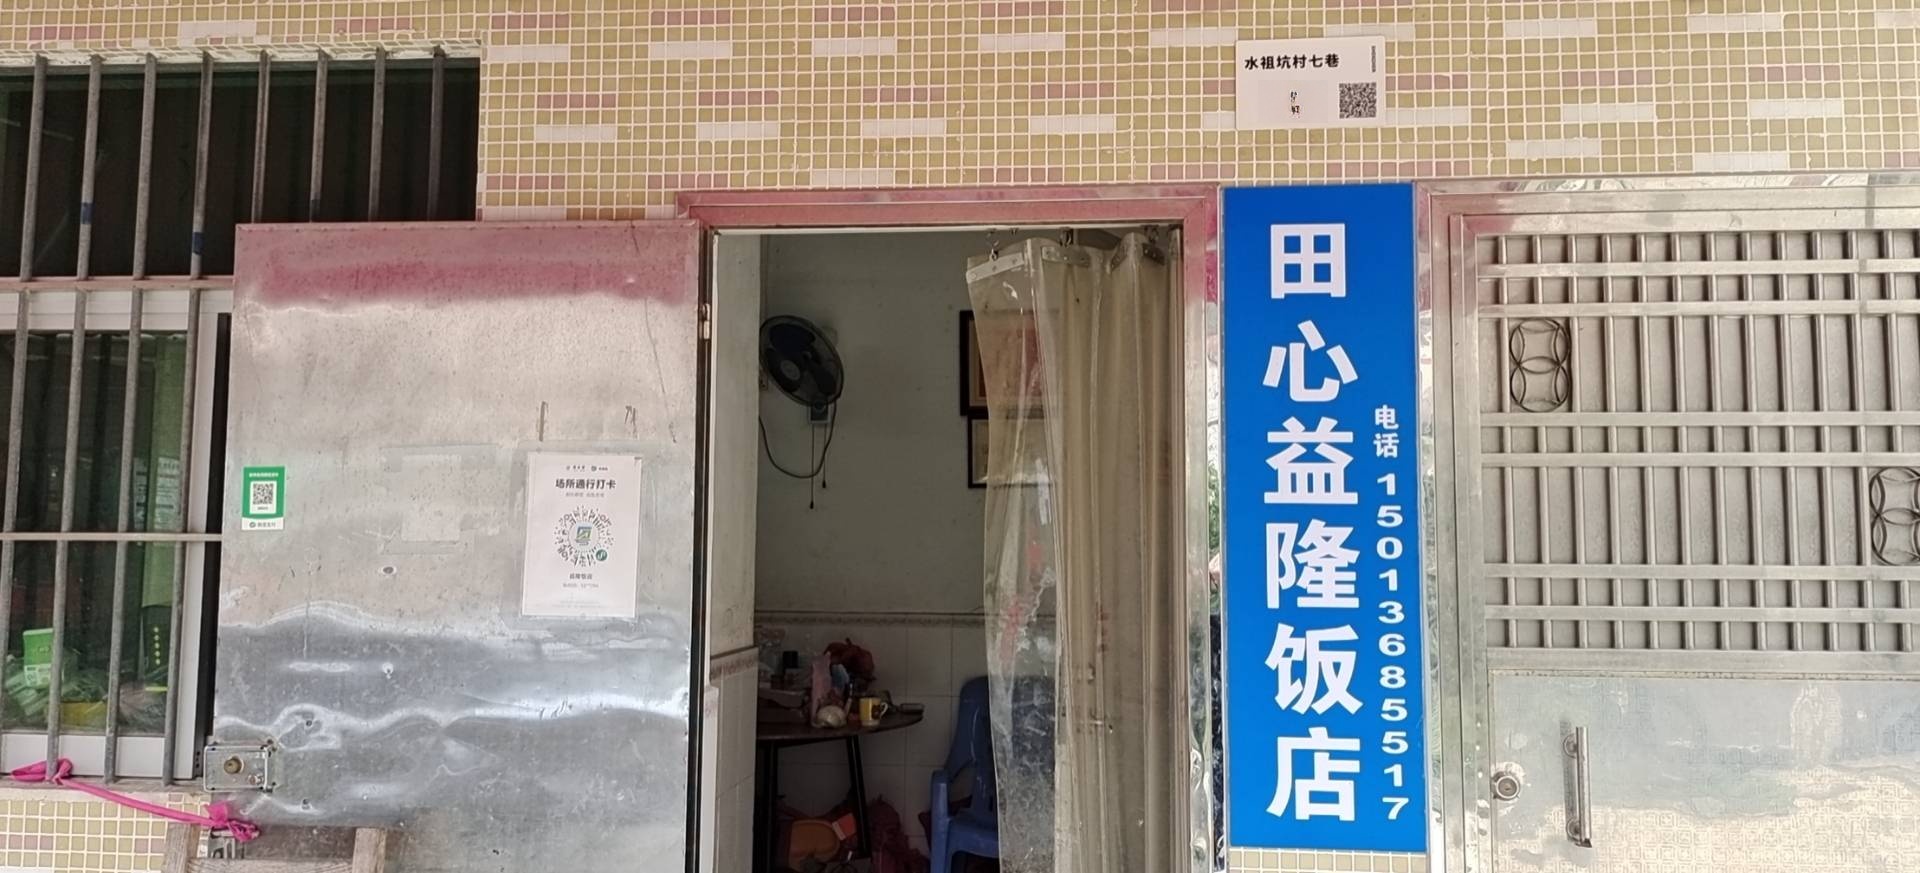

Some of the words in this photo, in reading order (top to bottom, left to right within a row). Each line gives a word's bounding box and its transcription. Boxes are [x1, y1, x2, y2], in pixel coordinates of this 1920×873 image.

[1244, 53, 1340, 70] 水祖坑村七巷
[1373, 405, 1399, 458] 电话
[555, 478, 616, 490] 场所通行打卡
[1262, 223, 1363, 821] 田心益隆饭店
[1376, 473, 1409, 820] 15013685517
